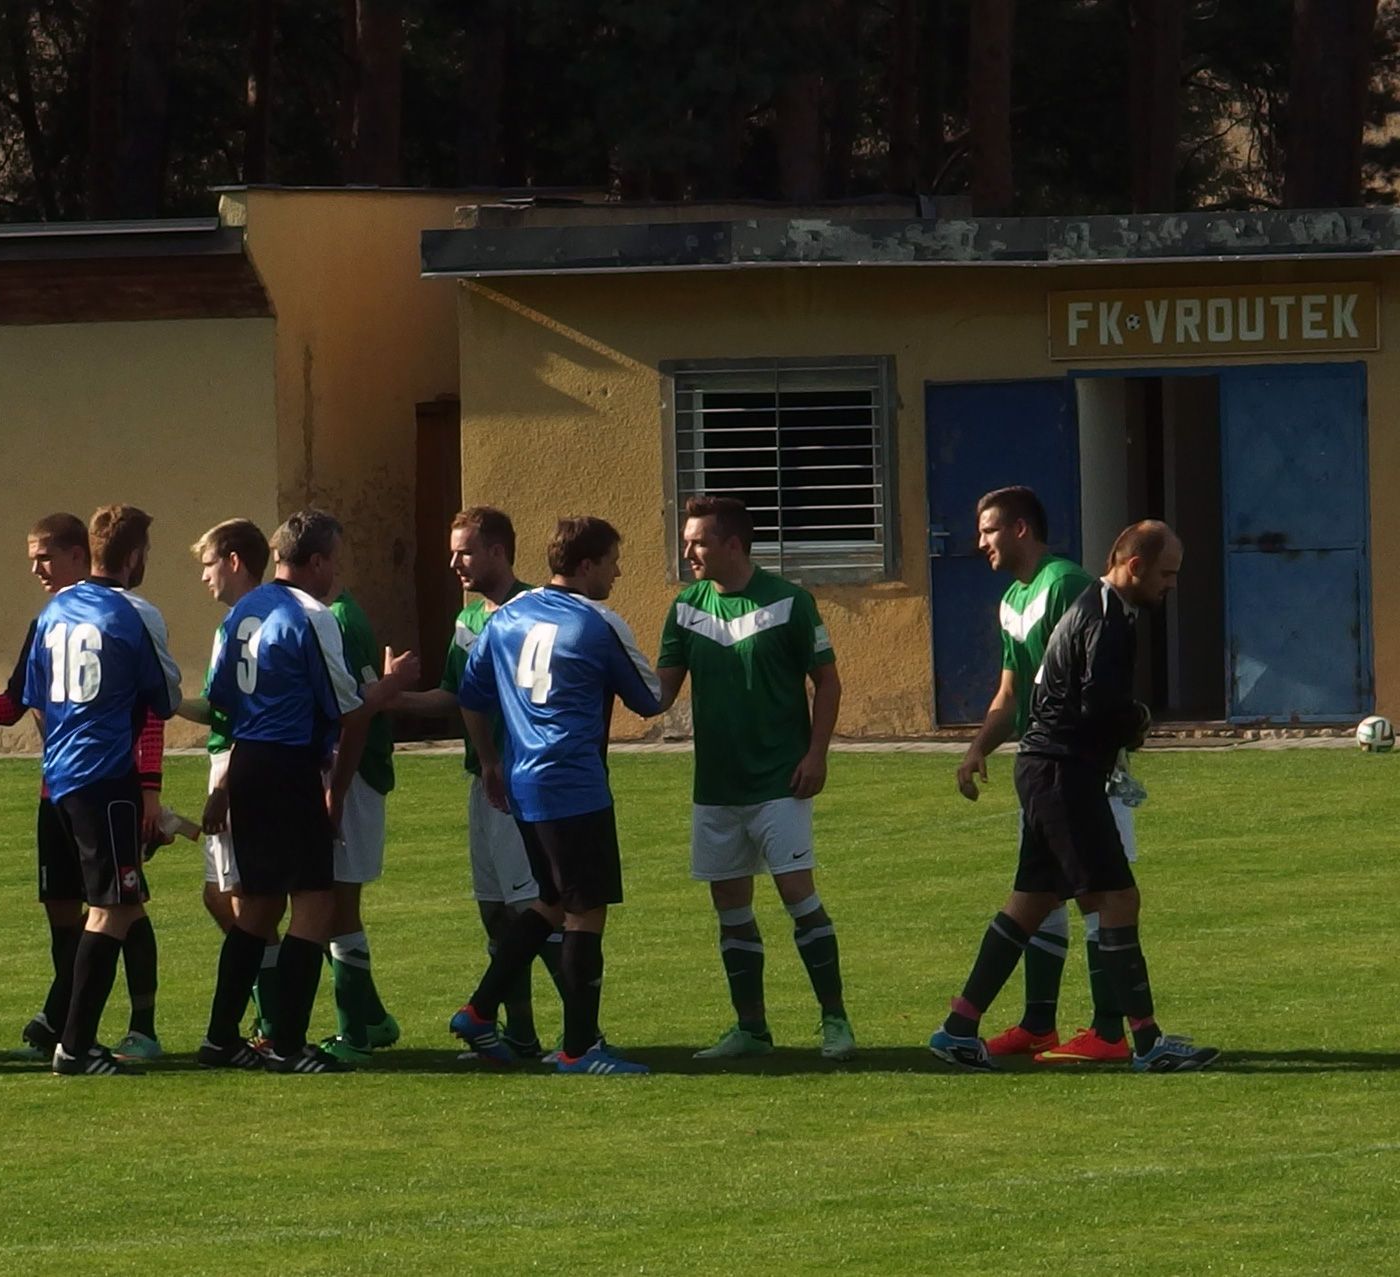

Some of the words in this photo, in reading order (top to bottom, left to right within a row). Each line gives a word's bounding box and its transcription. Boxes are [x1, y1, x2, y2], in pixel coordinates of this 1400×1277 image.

[1067, 301, 1124, 346] FK
[1145, 294, 1359, 344] VROUTEK
[45, 622, 103, 704] 16
[236, 616, 261, 695] 3
[517, 622, 558, 704] 4
